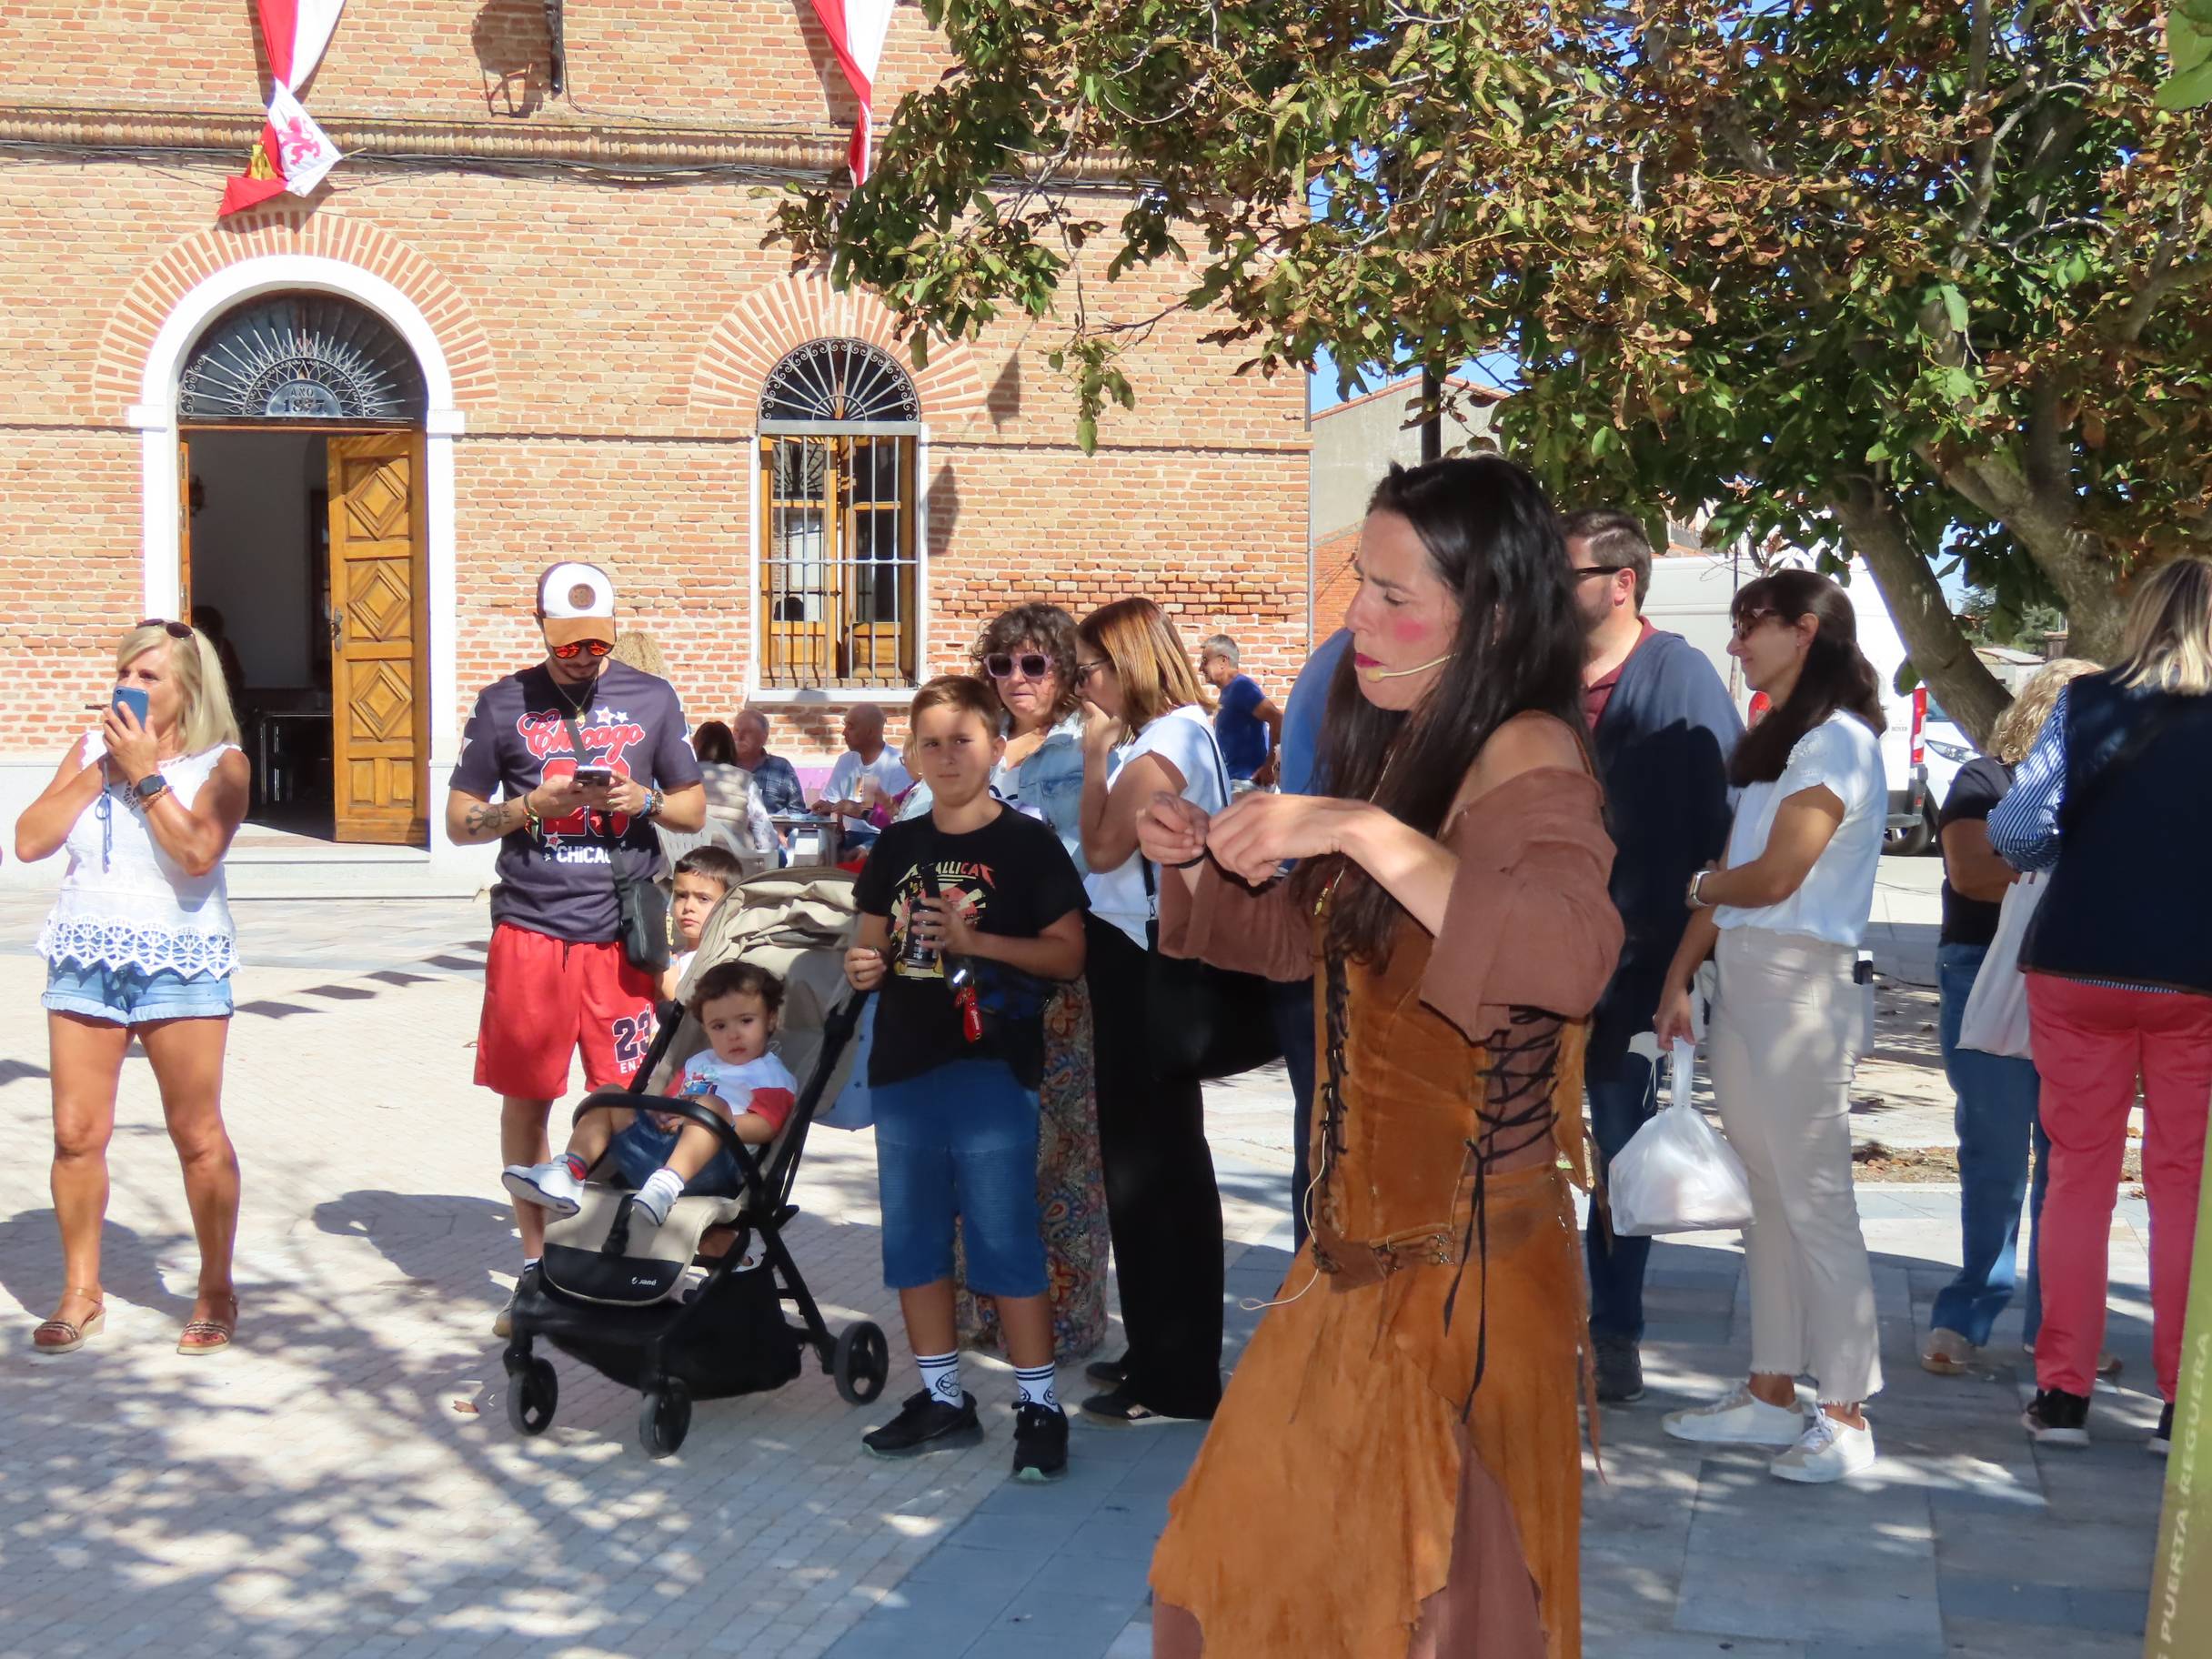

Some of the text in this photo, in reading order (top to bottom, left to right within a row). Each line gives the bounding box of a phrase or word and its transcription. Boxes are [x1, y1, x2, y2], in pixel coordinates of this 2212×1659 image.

[291, 385, 314, 397] AÑO
[517, 709, 646, 764] Chcago
[2160, 1509, 2188, 1644] PUERTA
[2178, 1332, 2210, 1496] REGUERA
